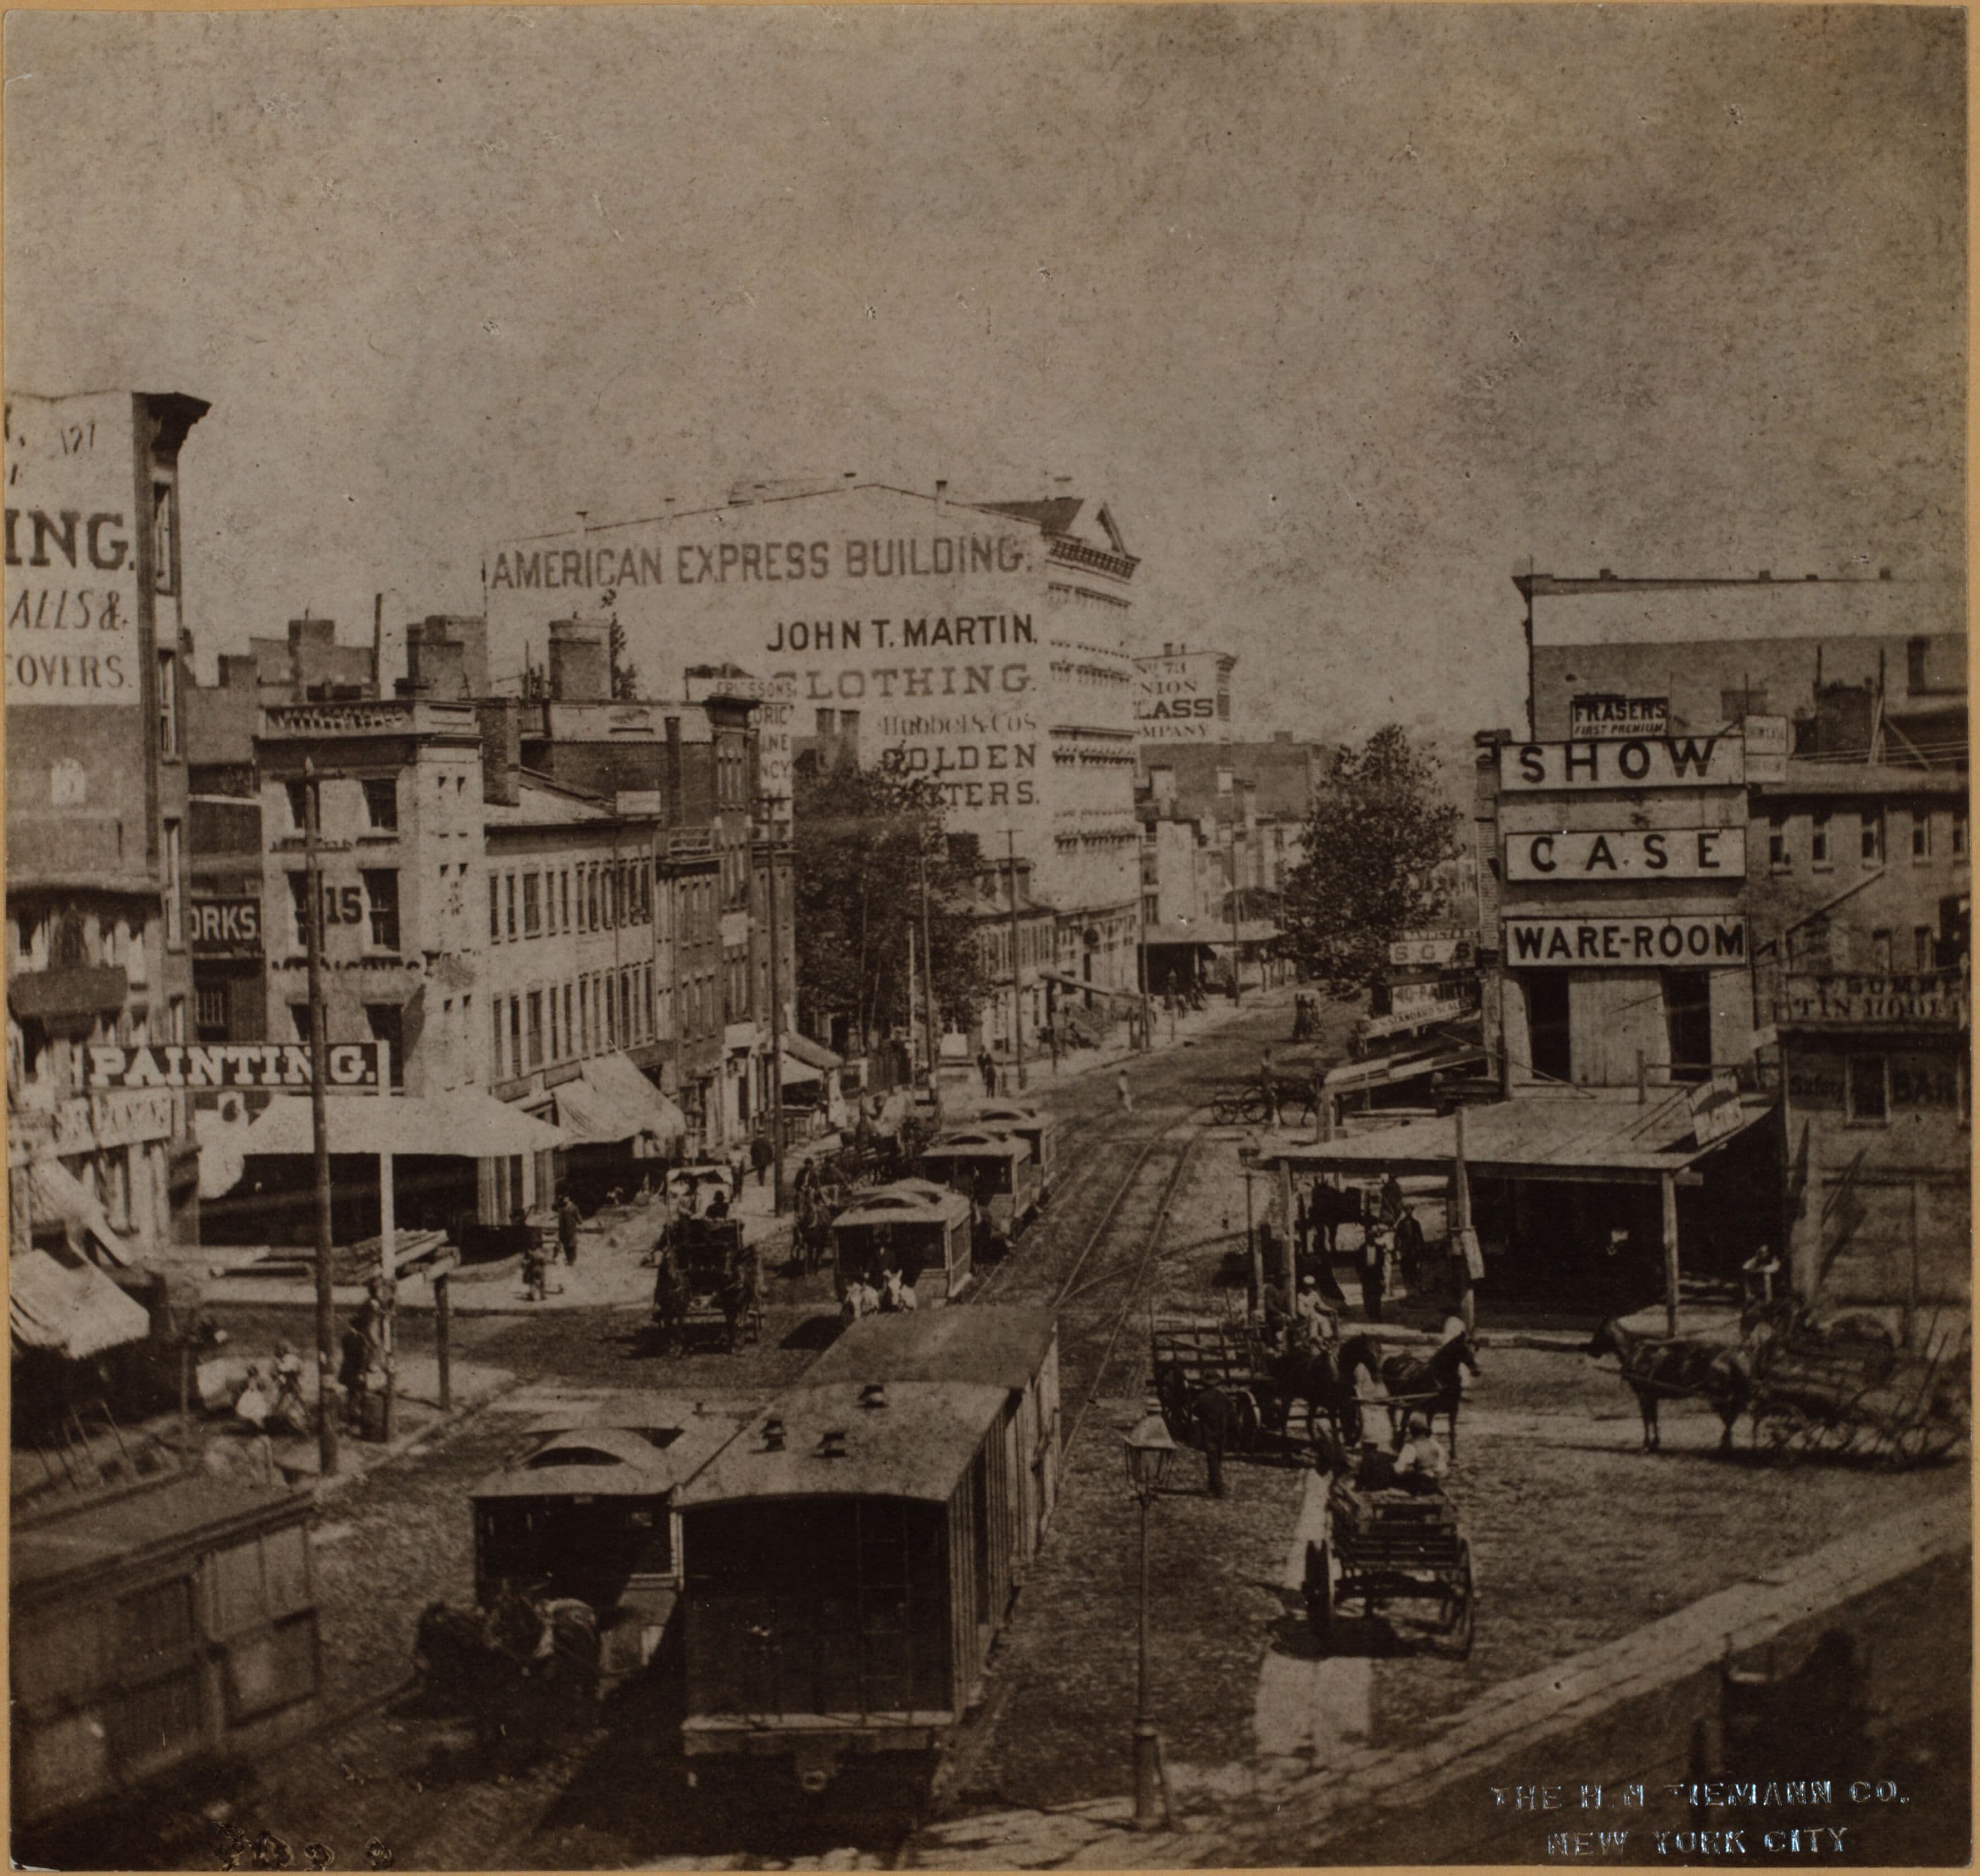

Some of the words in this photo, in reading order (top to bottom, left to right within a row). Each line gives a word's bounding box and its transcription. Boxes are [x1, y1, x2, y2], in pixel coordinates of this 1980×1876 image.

[491, 548, 662, 590] AMERICAN
[677, 540, 829, 585] EXPRESS
[846, 536, 1032, 578] BUILDING.
[766, 619, 861, 652] JOHN
[871, 619, 894, 648] T.
[904, 613, 1037, 648] MARTIN.
[5, 654, 133, 689] OVERS.
[773, 664, 1036, 700] LOTHING.
[1139, 680, 1197, 694] NION
[1132, 698, 1214, 720] LASS
[1574, 725, 1607, 735] FIRST
[1519, 738, 1716, 783] SHOW
[1530, 833, 1720, 873] CASE
[326, 886, 363, 924] 15
[1514, 924, 1744, 960] WARE-ROOM
[90, 1045, 377, 1087] PAINTING.
